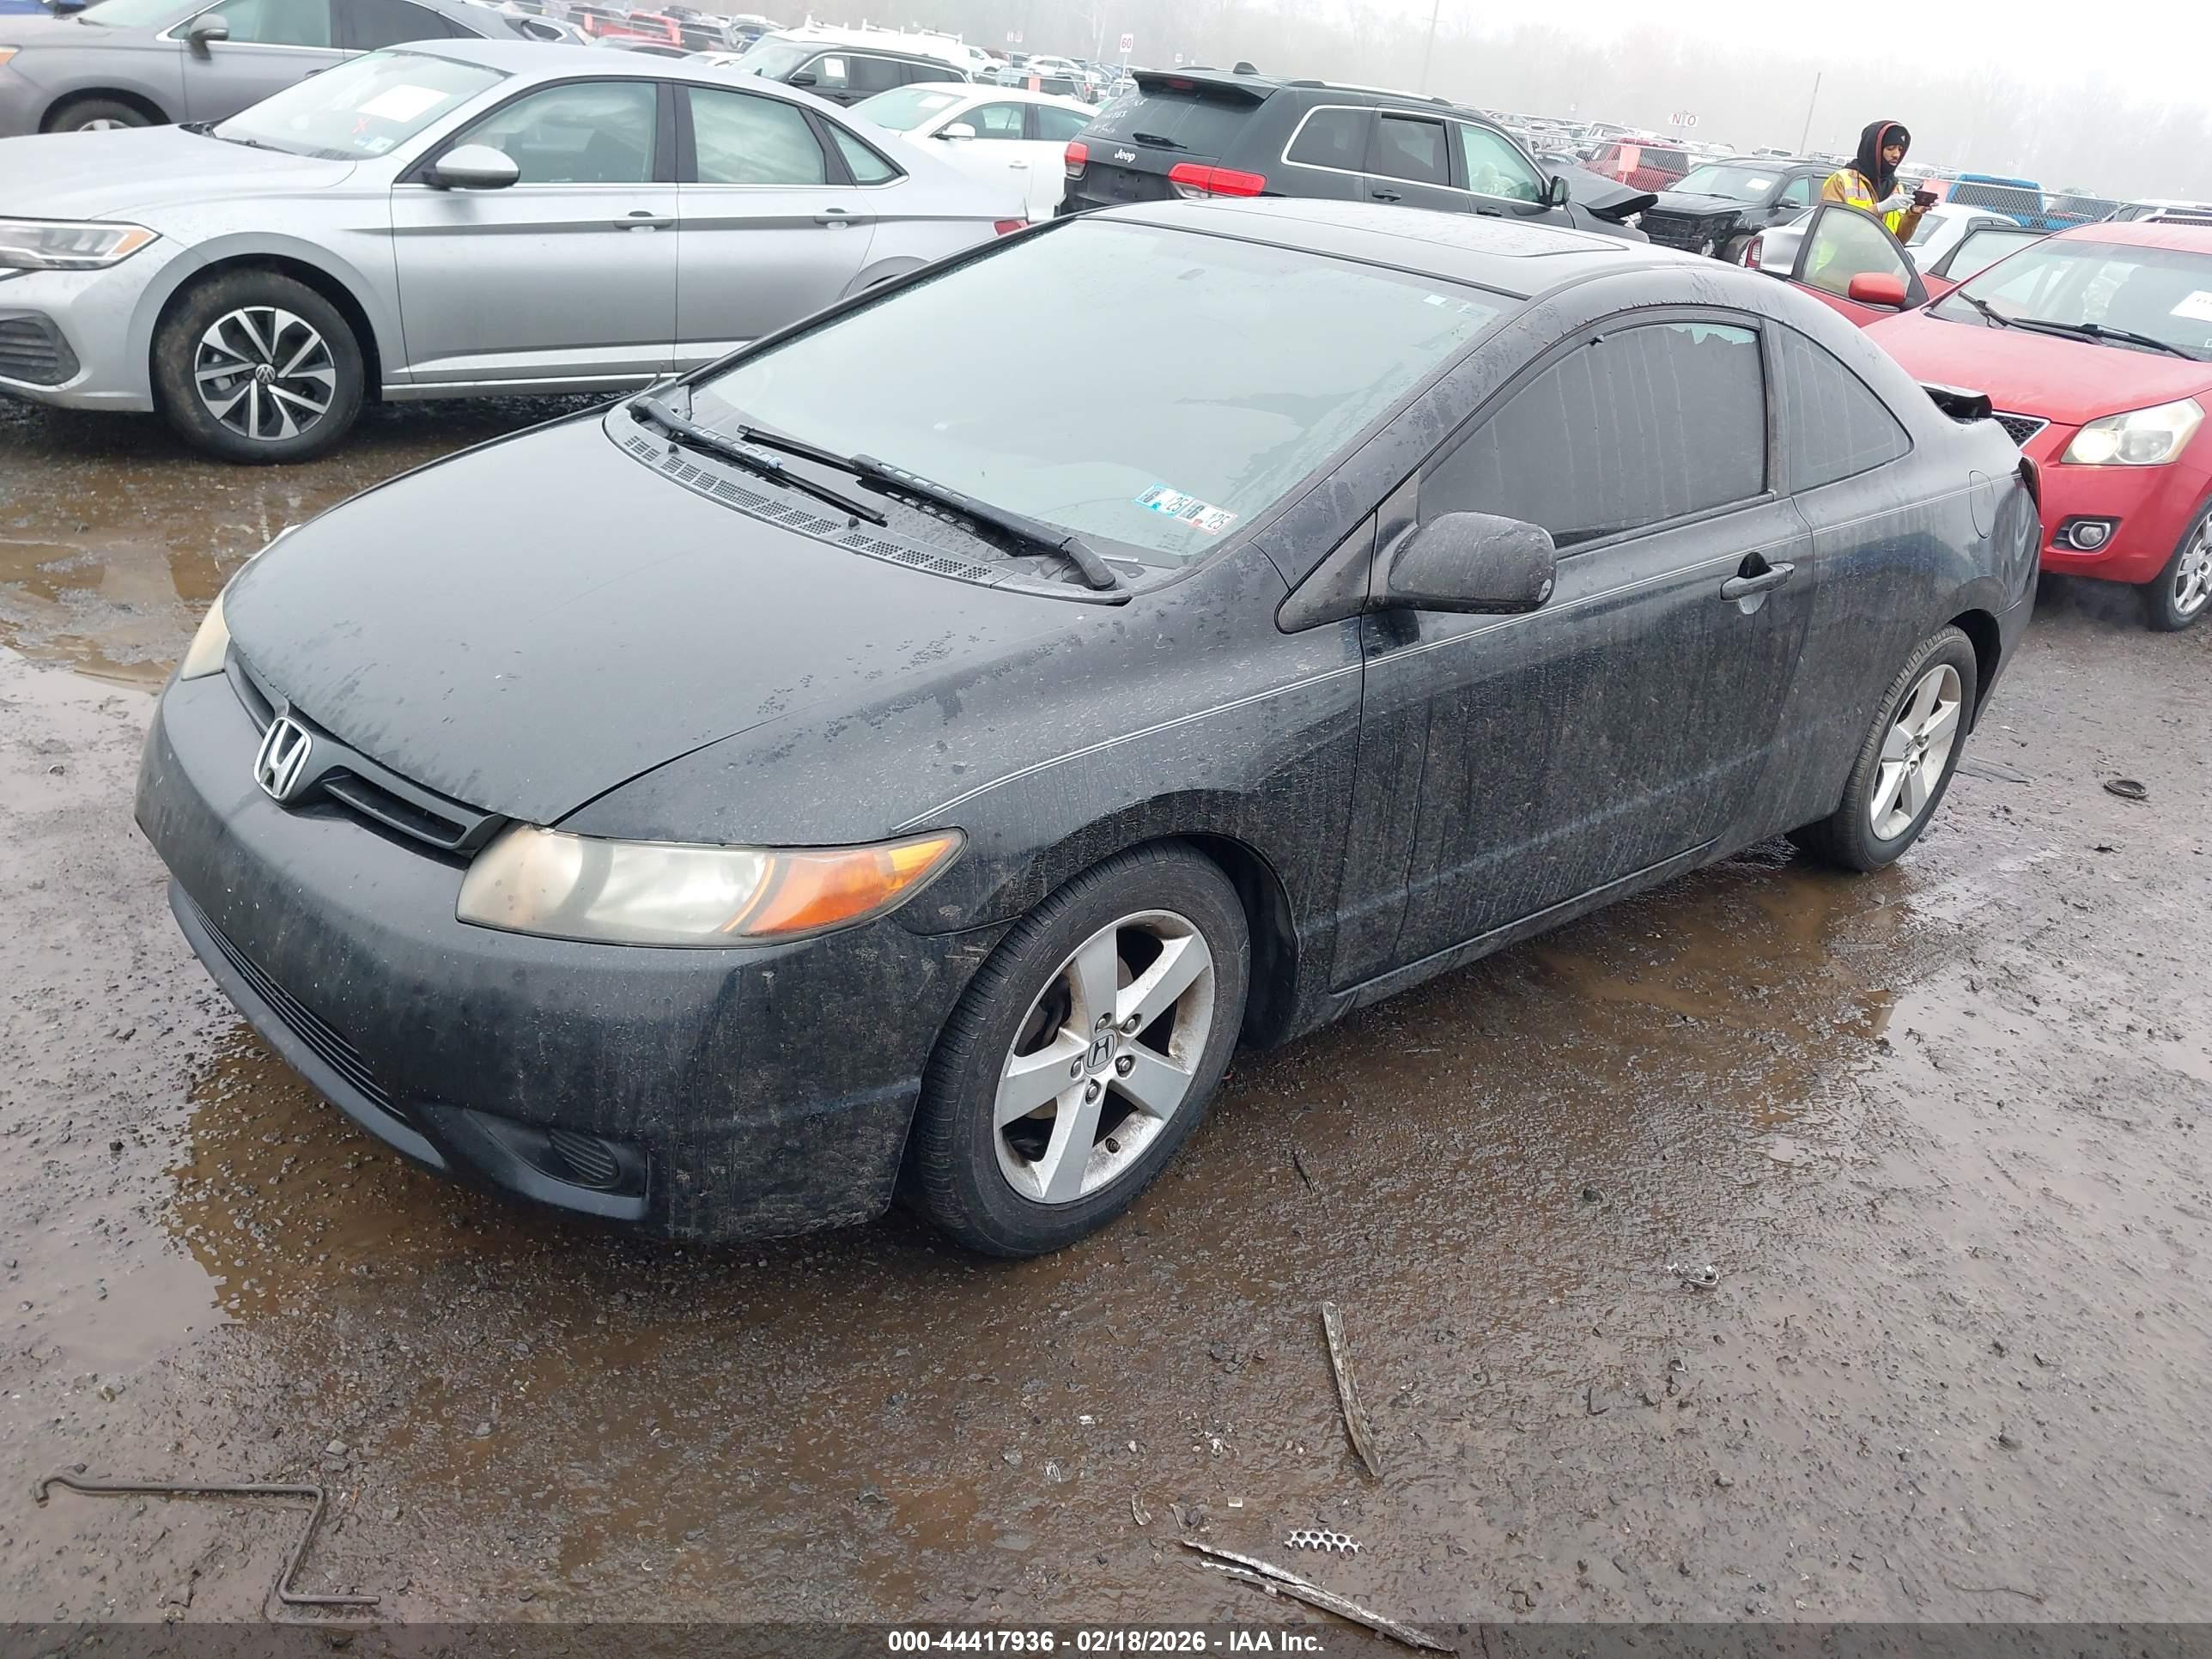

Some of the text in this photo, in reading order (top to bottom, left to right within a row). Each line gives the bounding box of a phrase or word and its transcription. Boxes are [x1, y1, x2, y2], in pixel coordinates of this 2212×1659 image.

[1121, 37, 1132, 49] 60
[1114, 148, 1136, 163] Jeep
[1166, 496, 1189, 512] 25
[1207, 514, 1231, 530] 25
